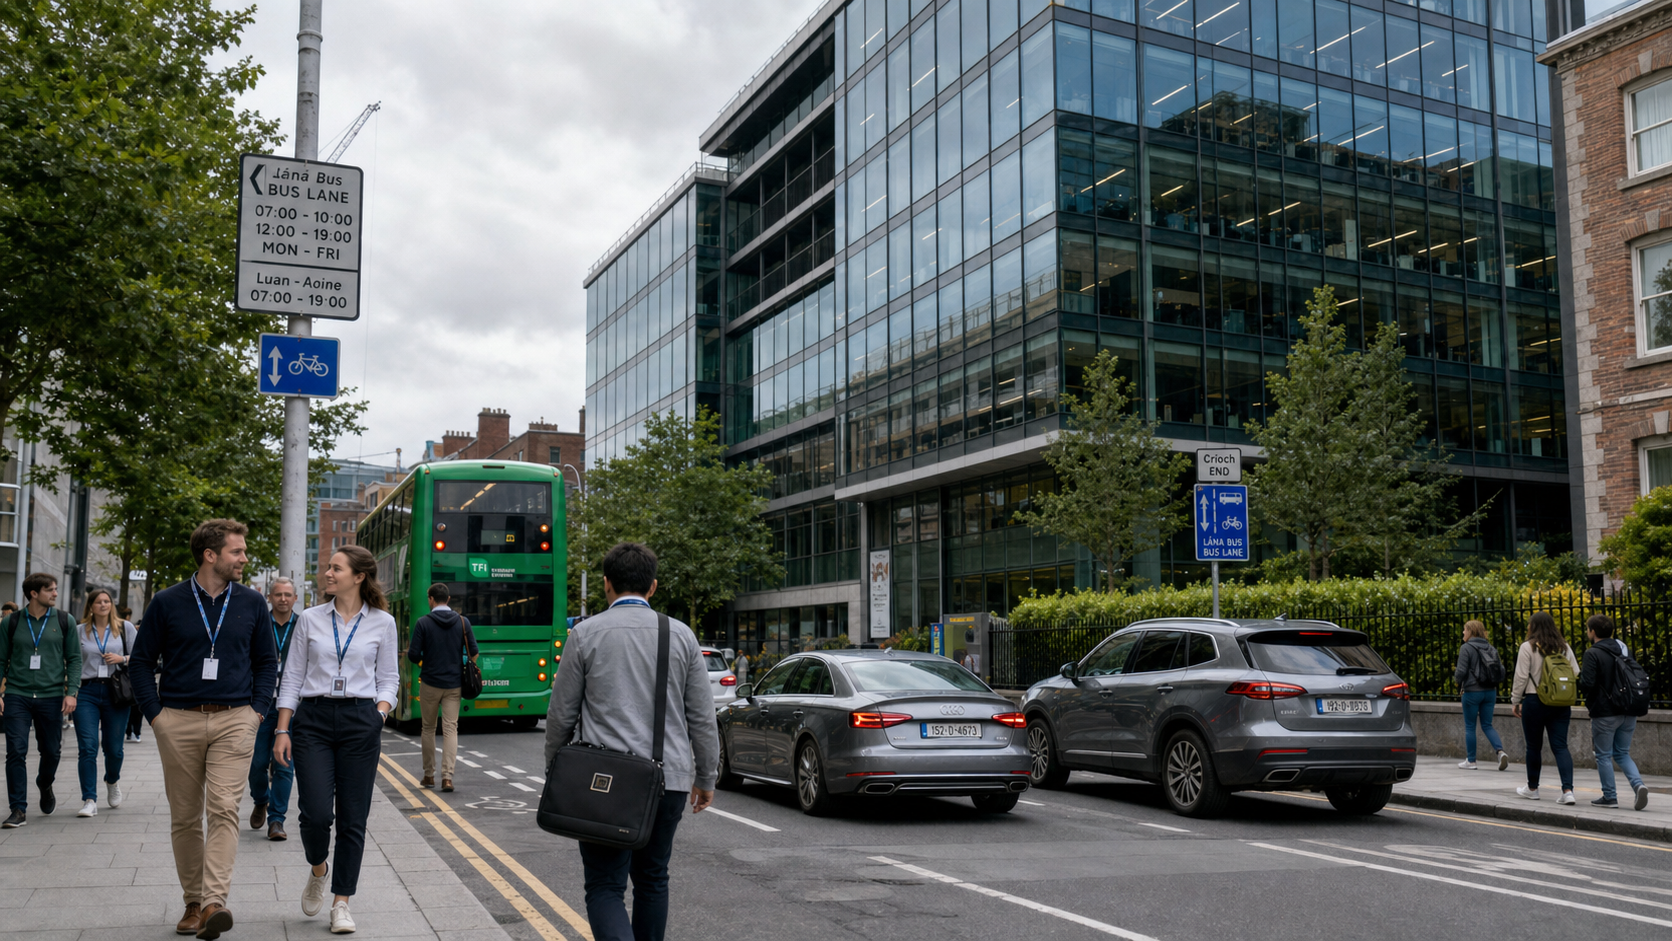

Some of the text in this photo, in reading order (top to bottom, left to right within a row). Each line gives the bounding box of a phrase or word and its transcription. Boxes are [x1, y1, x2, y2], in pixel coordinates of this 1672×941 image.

[316, 171, 342, 186] Bus
[268, 183, 349, 204] BUS LANE
[255, 204, 297, 220] 07:00
[314, 211, 352, 226] 10:00
[255, 223, 295, 238] 12:00
[313, 229, 352, 244] 19:00
[262, 241, 298, 256] MON
[317, 246, 340, 260] FRI
[256, 272, 290, 286] Luan
[302, 276, 342, 291] Aoine
[250, 289, 292, 304] 07:00
[308, 294, 347, 309] 19:00
[1209, 466, 1230, 476] END
[1226, 538, 1243, 546] BUS
[1203, 548, 1243, 557] BUS LANE
[472, 563, 487, 572] TFI
